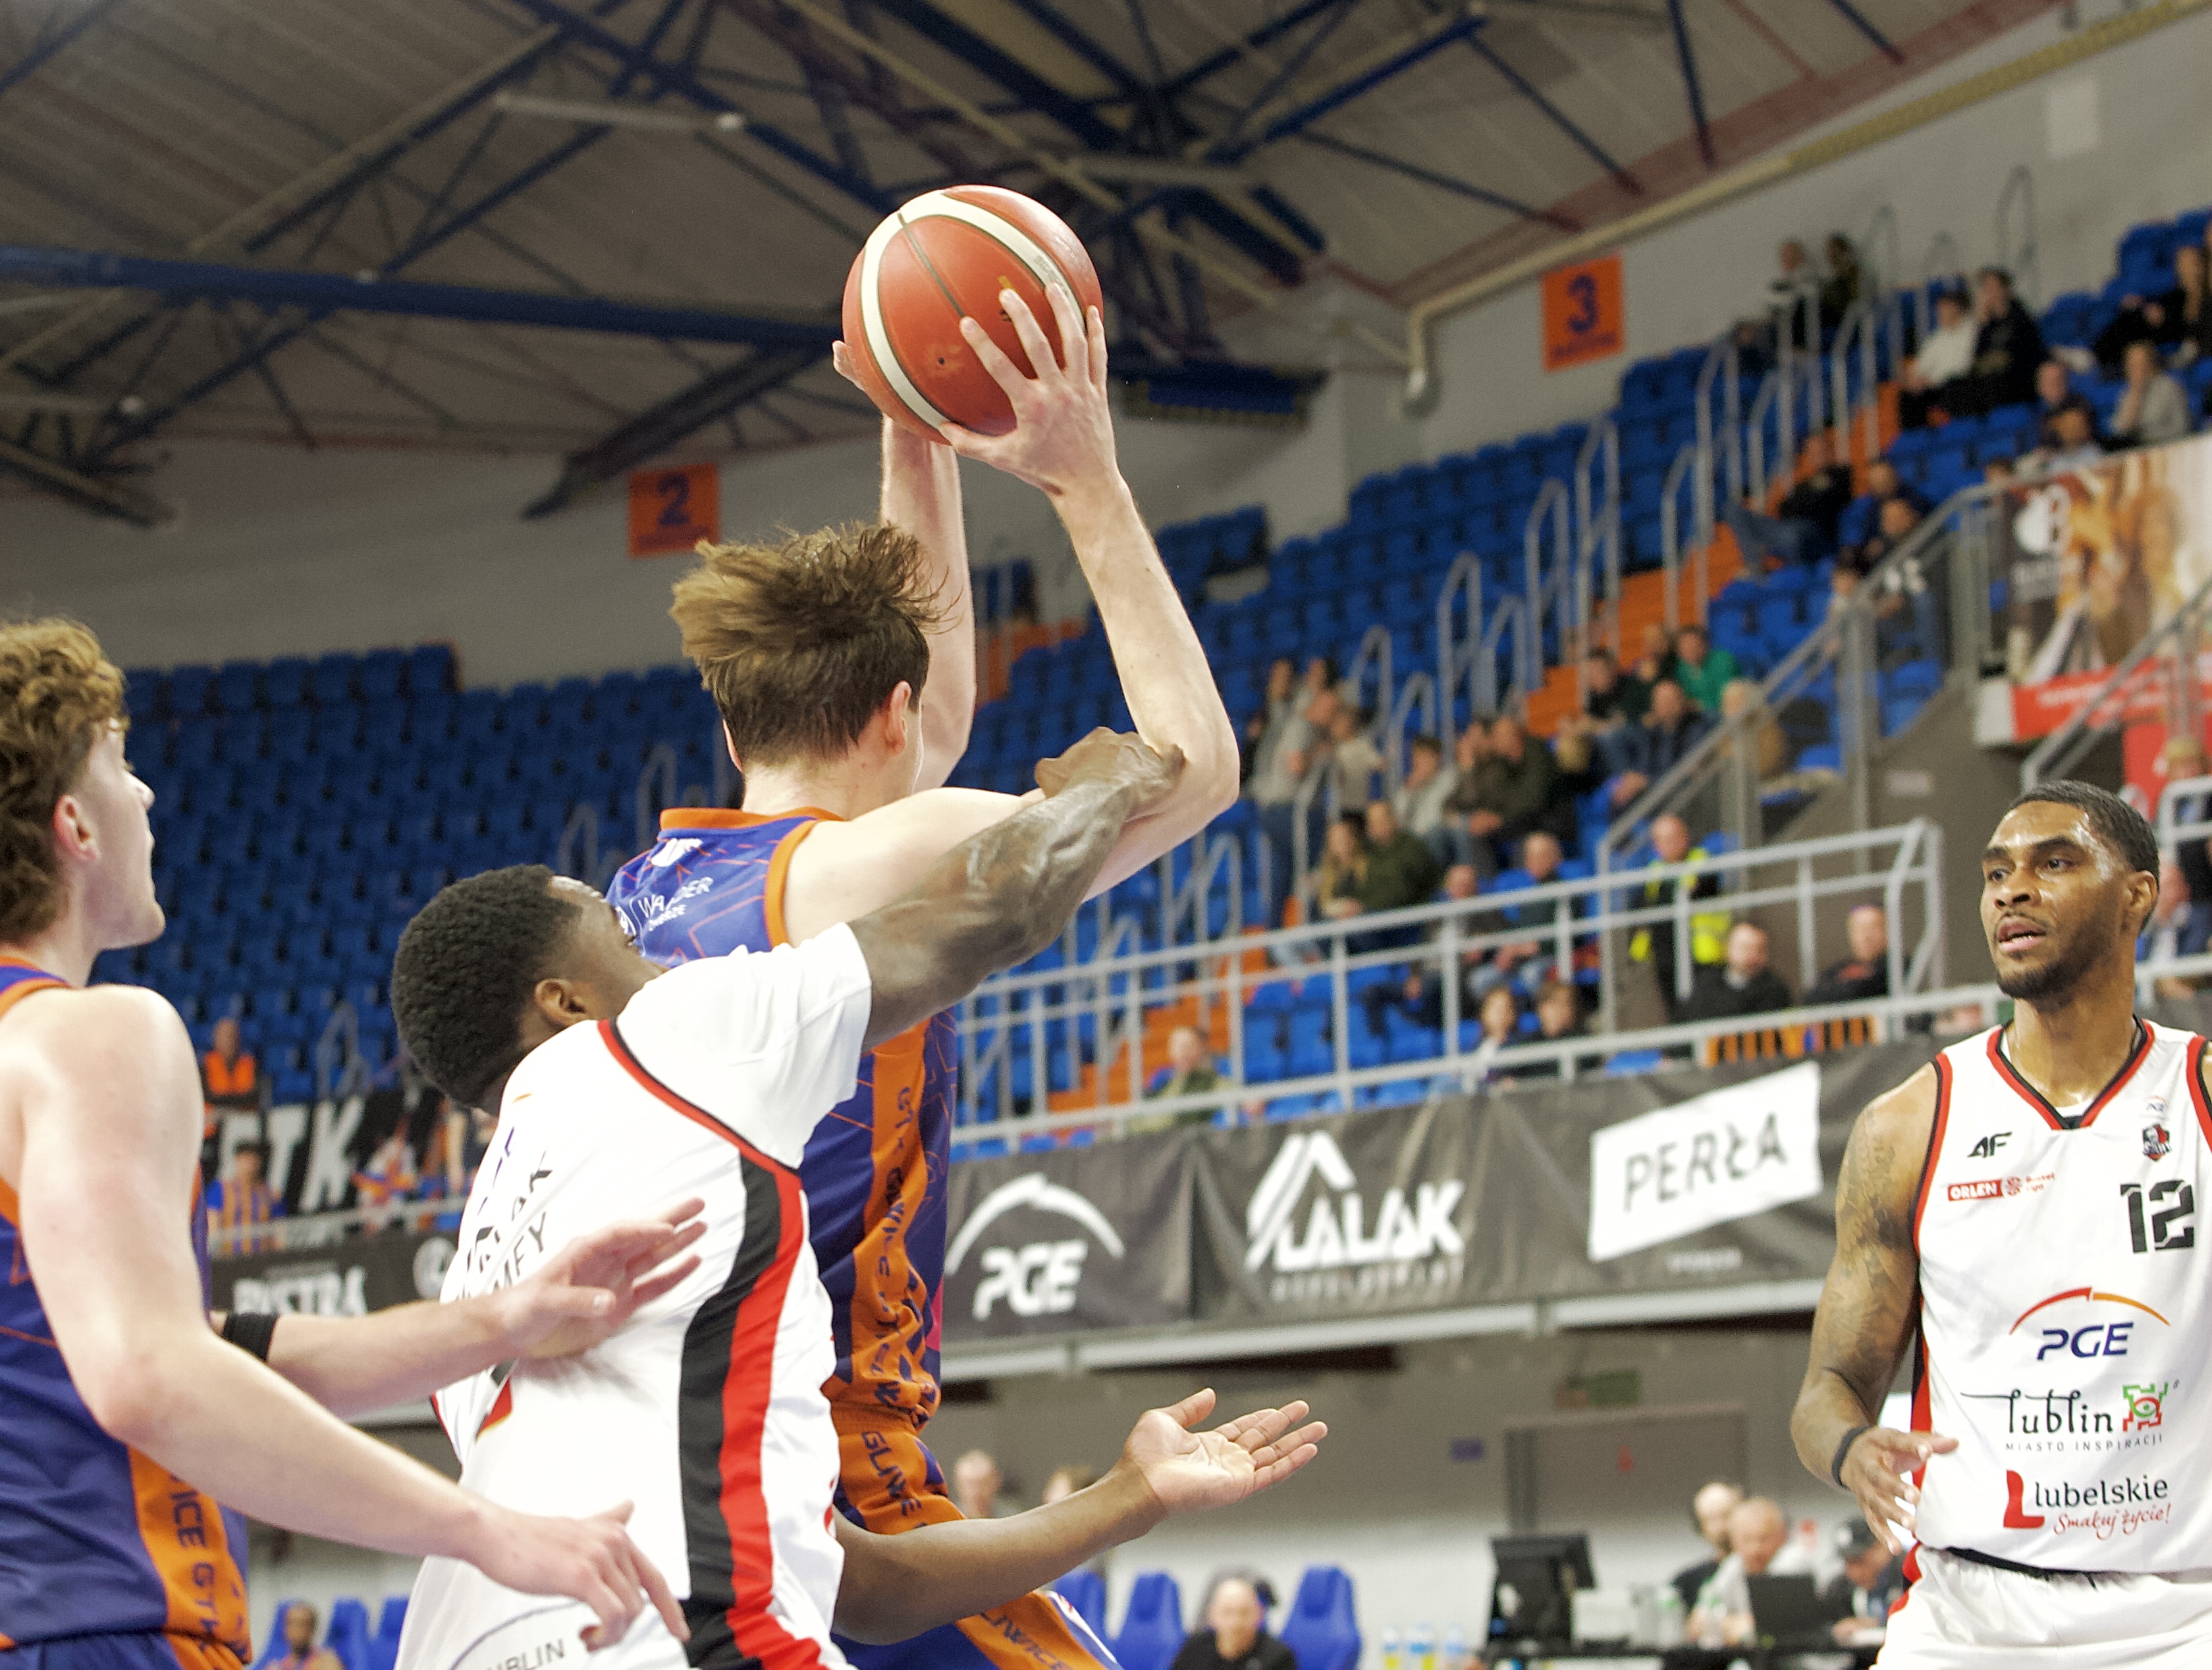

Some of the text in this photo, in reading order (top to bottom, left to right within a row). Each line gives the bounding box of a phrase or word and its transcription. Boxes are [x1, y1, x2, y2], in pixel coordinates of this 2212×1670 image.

[1567, 273, 1599, 335] 3
[657, 471, 690, 526] 2
[1623, 1113, 1789, 1212] PERŁA
[1950, 1181, 1998, 1200] ORLEN
[1274, 1181, 1466, 1272] LALAK
[2119, 1179, 2195, 1253] 12
[973, 1239, 1088, 1319] PGE
[2037, 1322, 2134, 1360] PGE
[1960, 1388, 2113, 1434] lublin
[2006, 1433, 2164, 1451] MIASTO INSPIRACJI
[2034, 1474, 2169, 1508] lubelskie
[2054, 1502, 2172, 1540] Smakuj życie!
